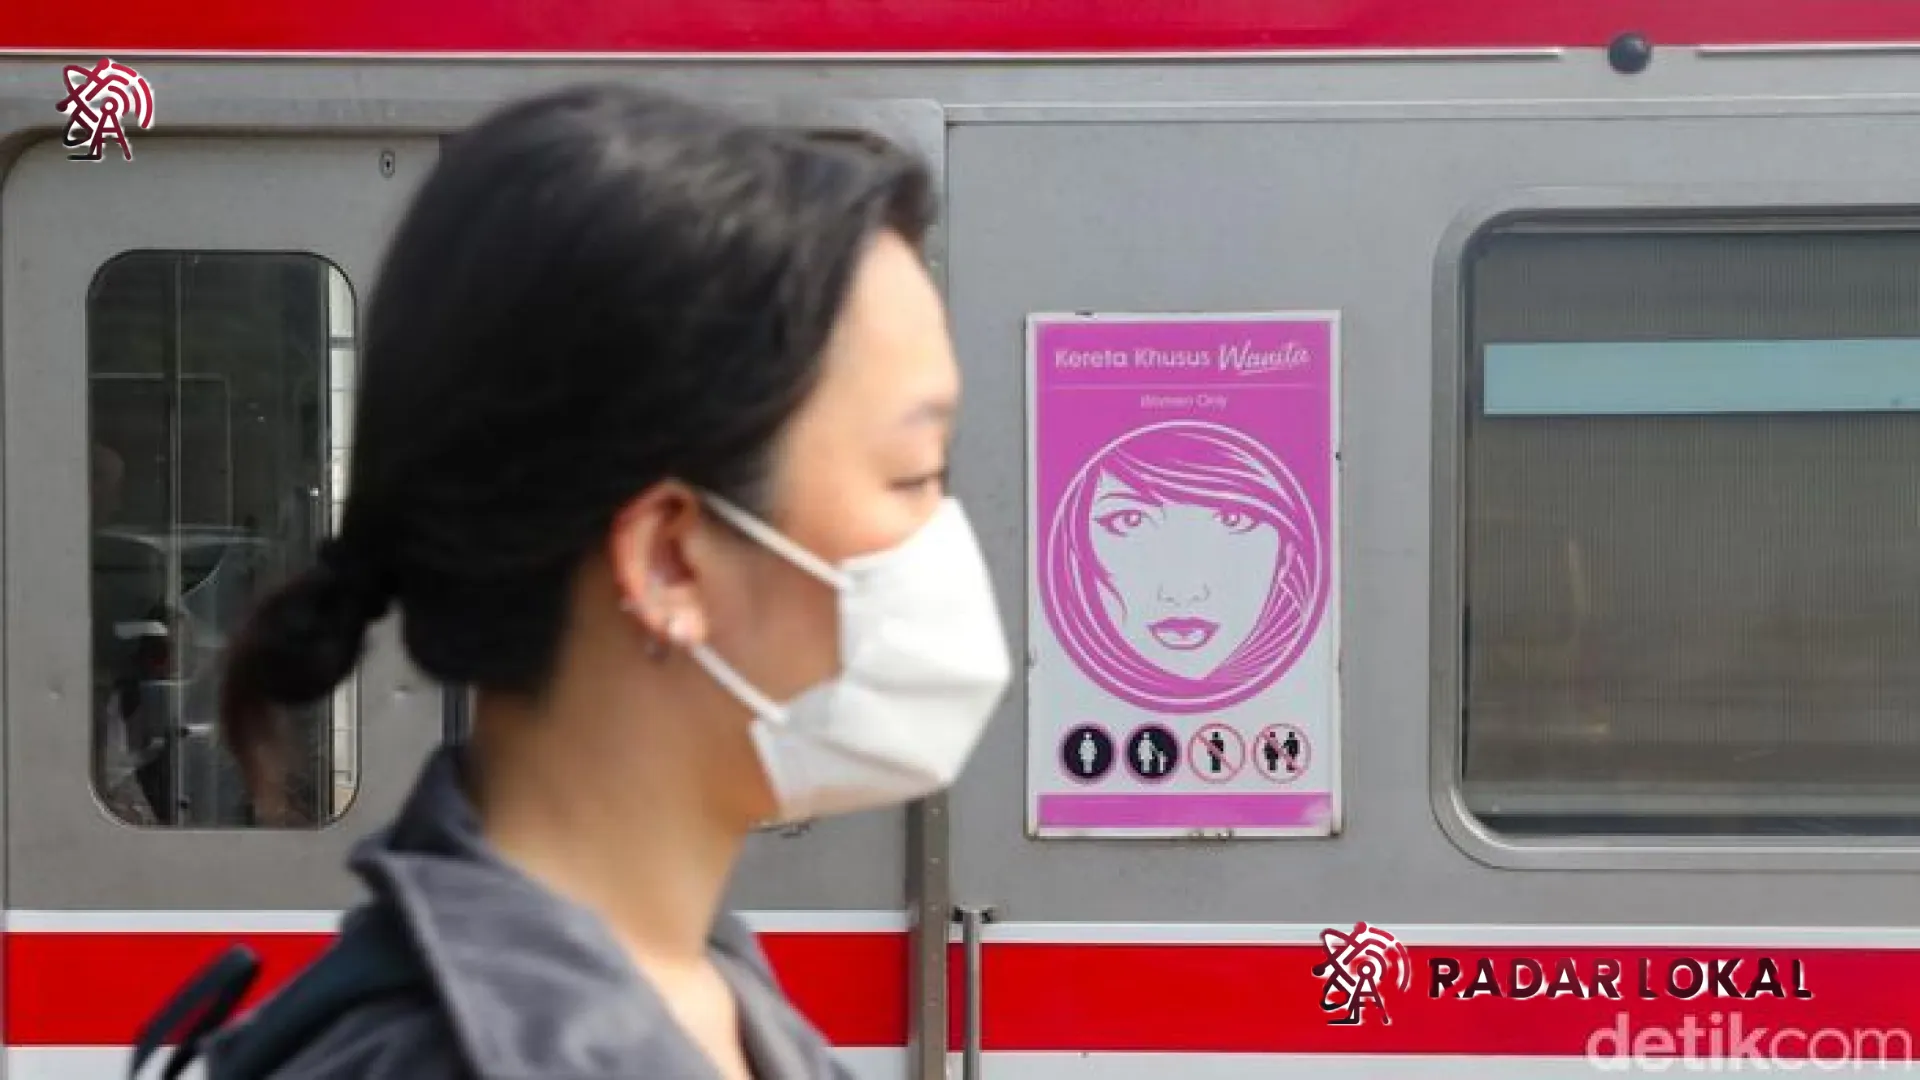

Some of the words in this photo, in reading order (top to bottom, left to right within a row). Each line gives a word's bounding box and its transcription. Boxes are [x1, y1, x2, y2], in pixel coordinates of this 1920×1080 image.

[1055, 350, 1128, 368] Kereta
[1134, 349, 1210, 368] Khusus
[1217, 340, 1312, 375] Wanita
